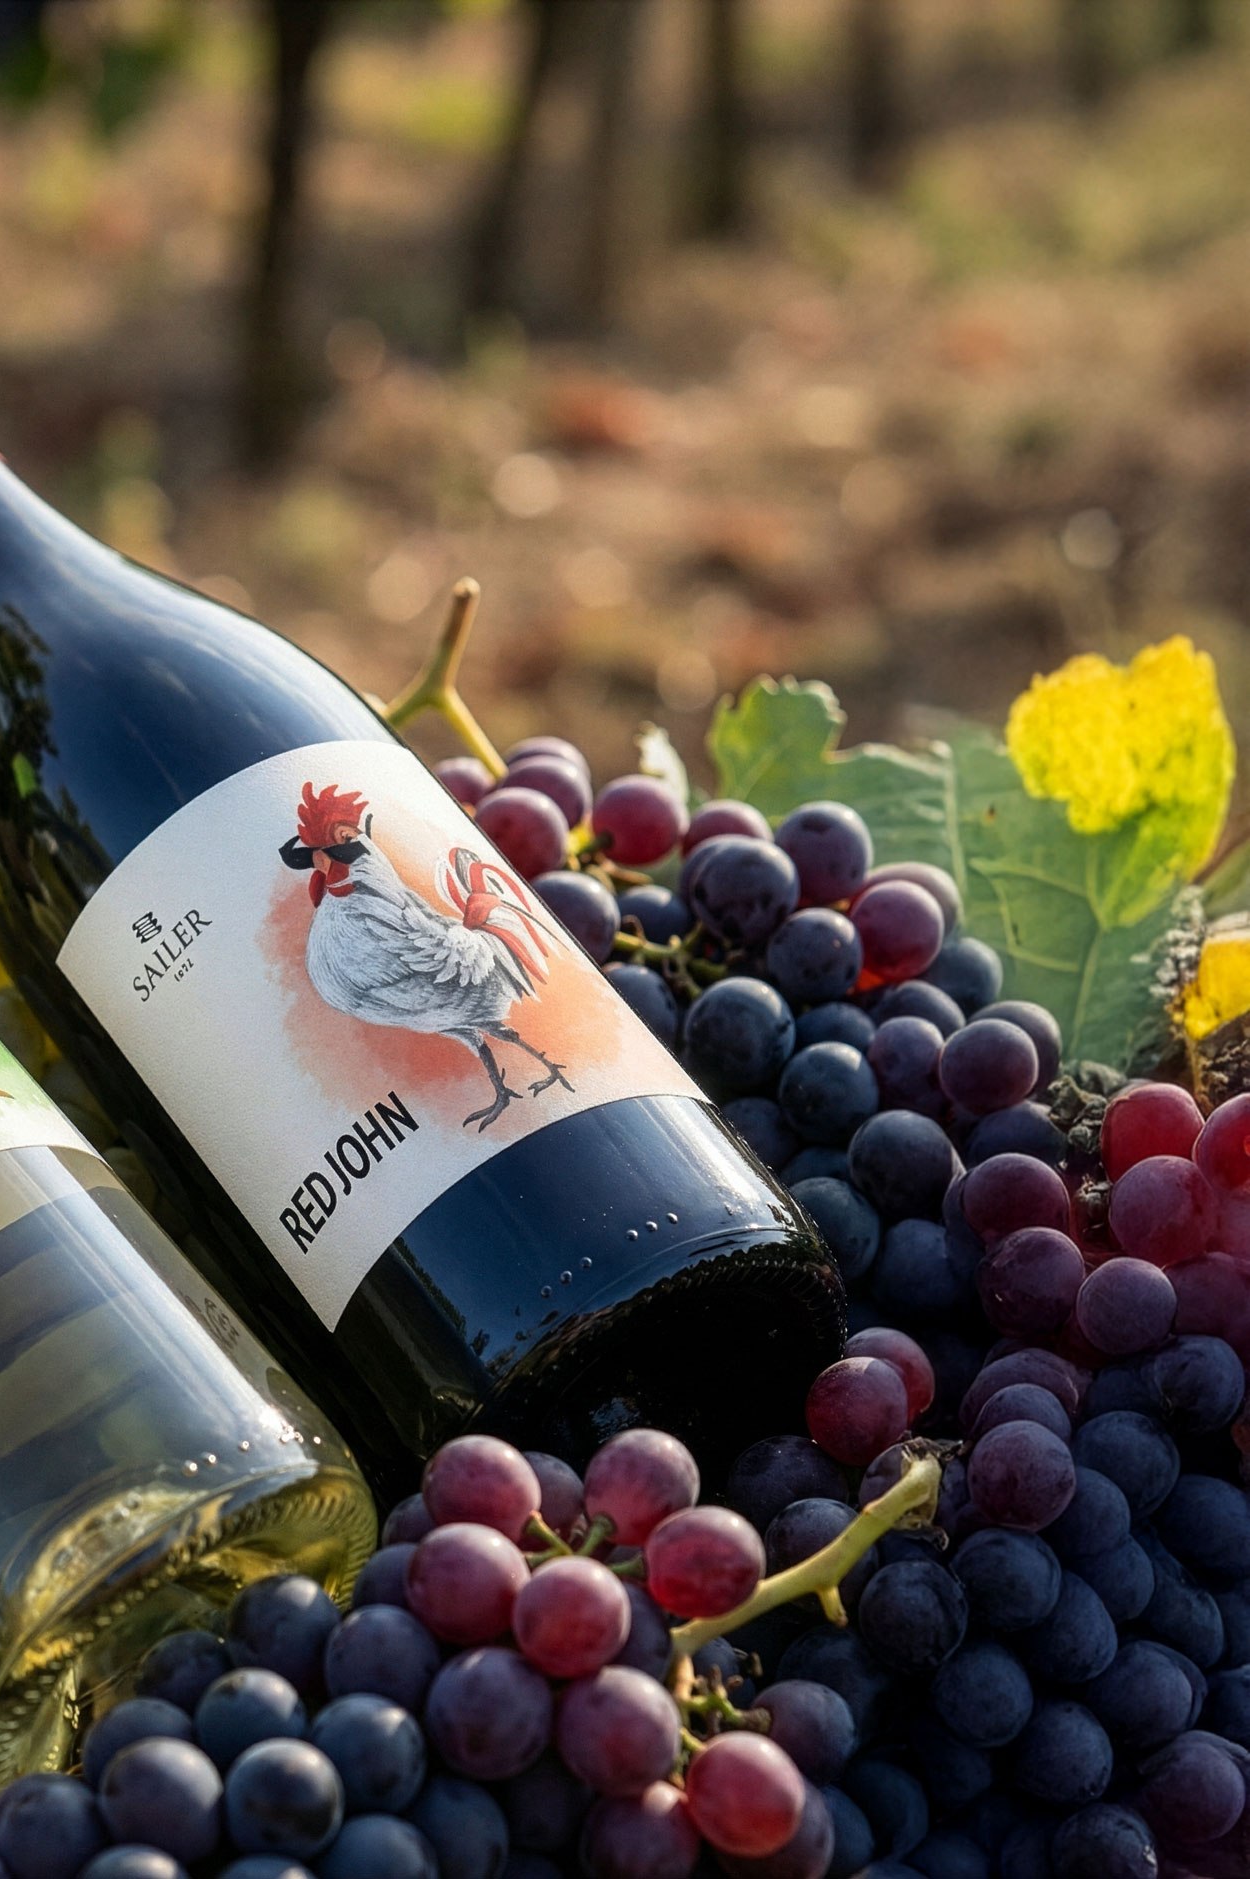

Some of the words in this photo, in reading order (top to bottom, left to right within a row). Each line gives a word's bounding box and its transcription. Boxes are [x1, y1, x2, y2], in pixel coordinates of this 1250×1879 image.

[131, 909, 213, 1003] SAILER
[278, 1171, 338, 1255] RED
[323, 1090, 420, 1196] JOHN
